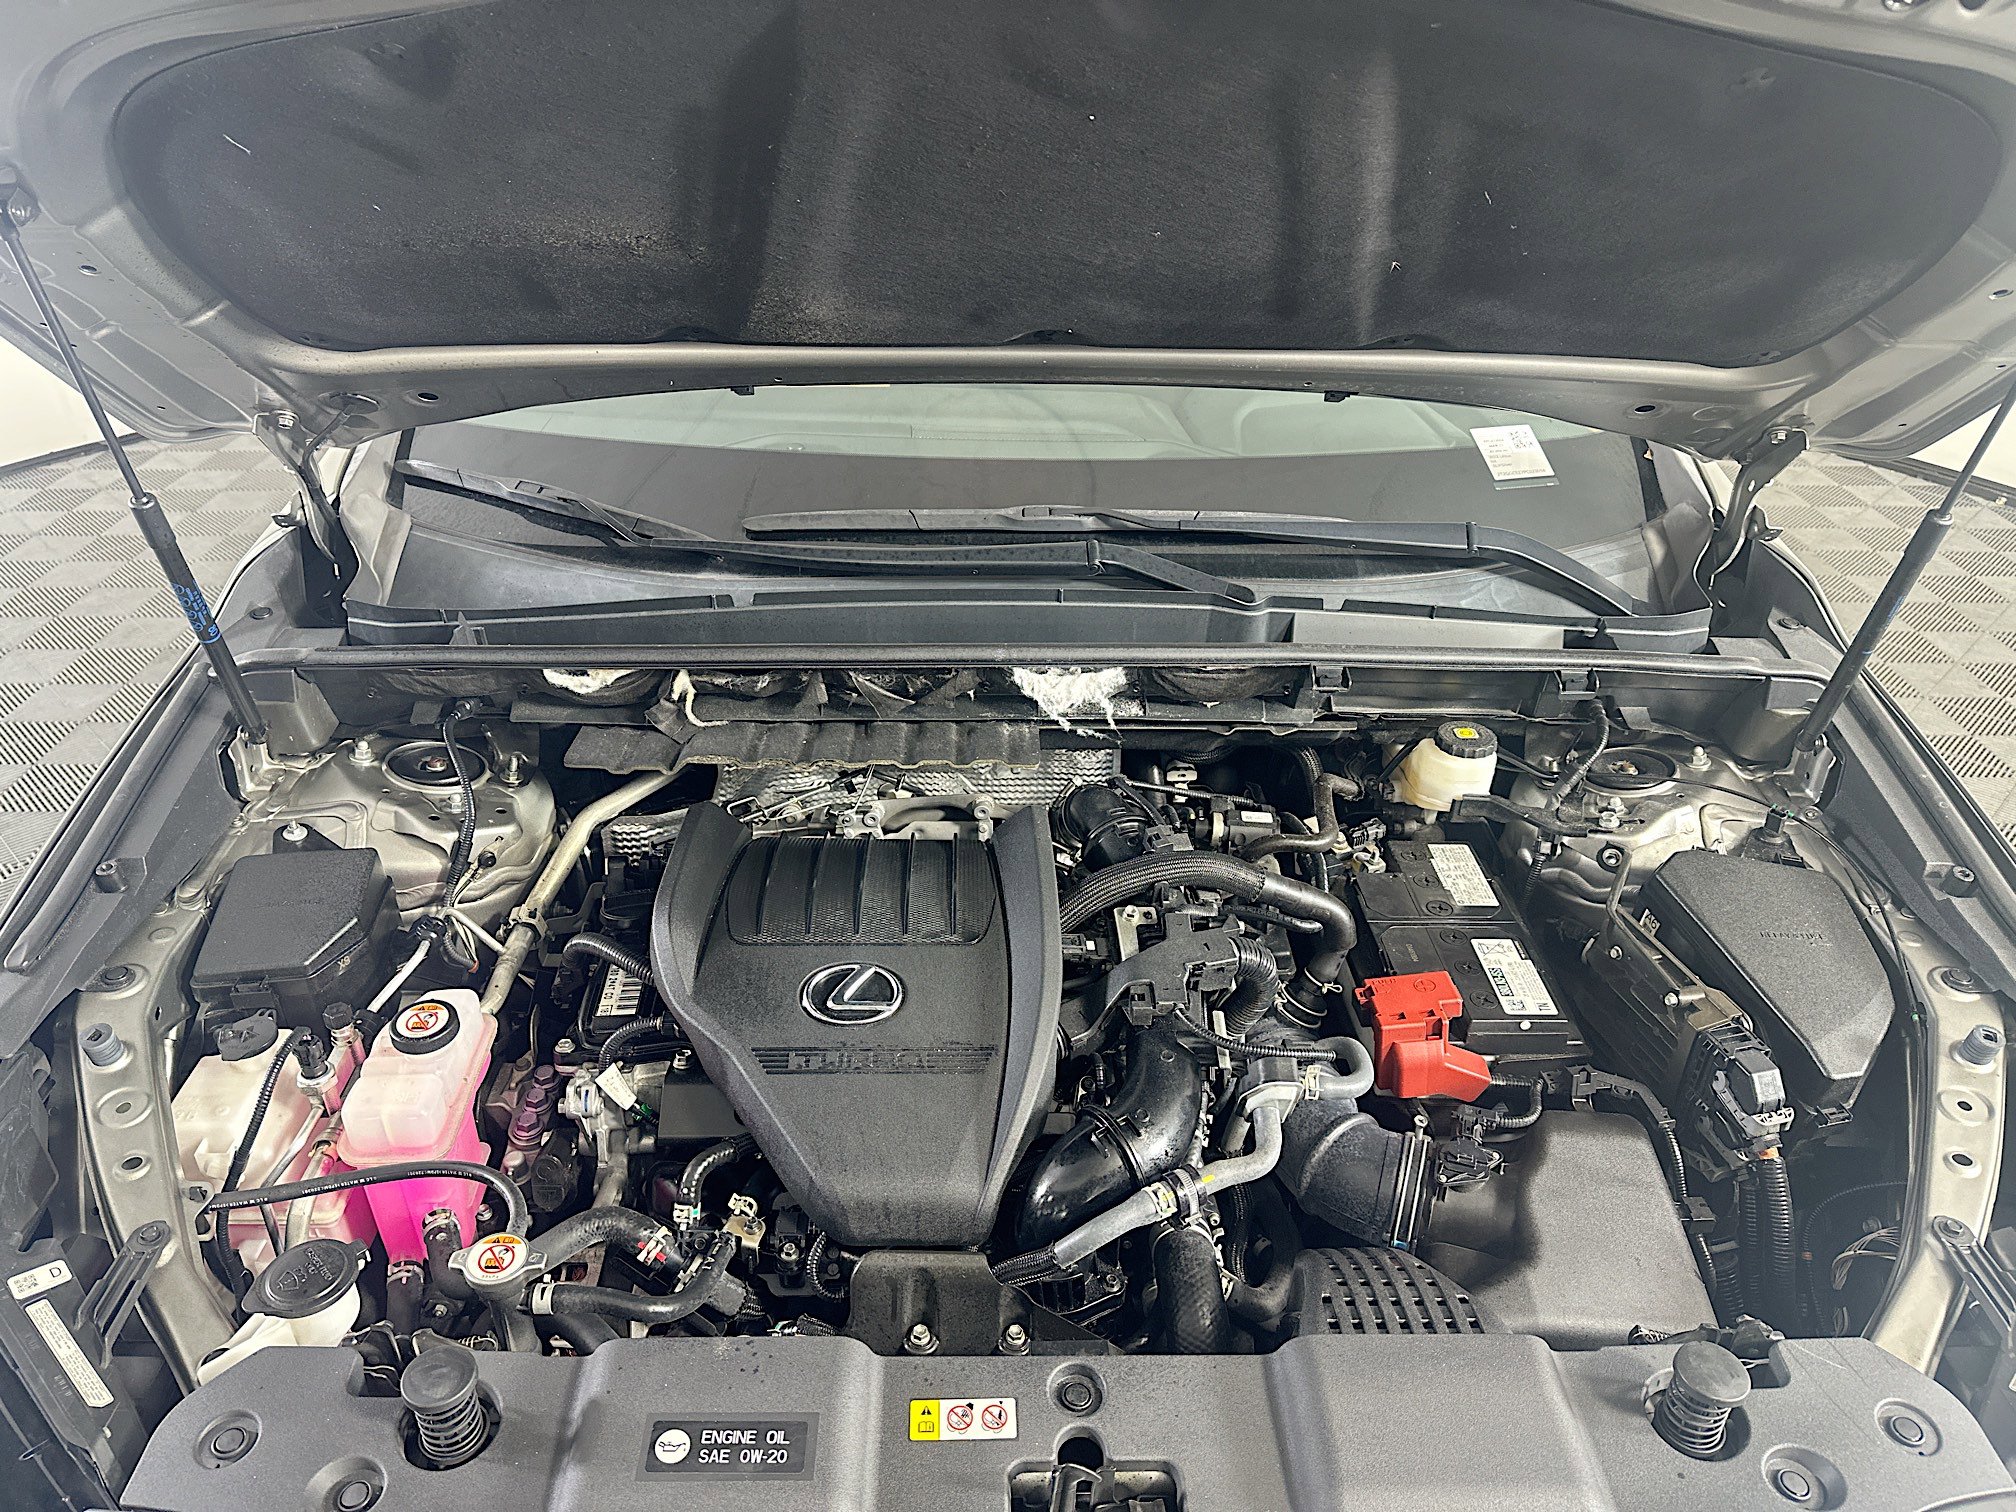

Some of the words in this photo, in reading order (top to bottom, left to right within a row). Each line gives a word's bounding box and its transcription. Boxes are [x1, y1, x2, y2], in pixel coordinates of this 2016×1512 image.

[48, 1266, 62, 1279] D
[700, 1429, 758, 1445] ENGINE
[765, 1429, 791, 1445] OIL
[698, 1448, 731, 1464] SAE
[739, 1448, 788, 1464] 0W-20
